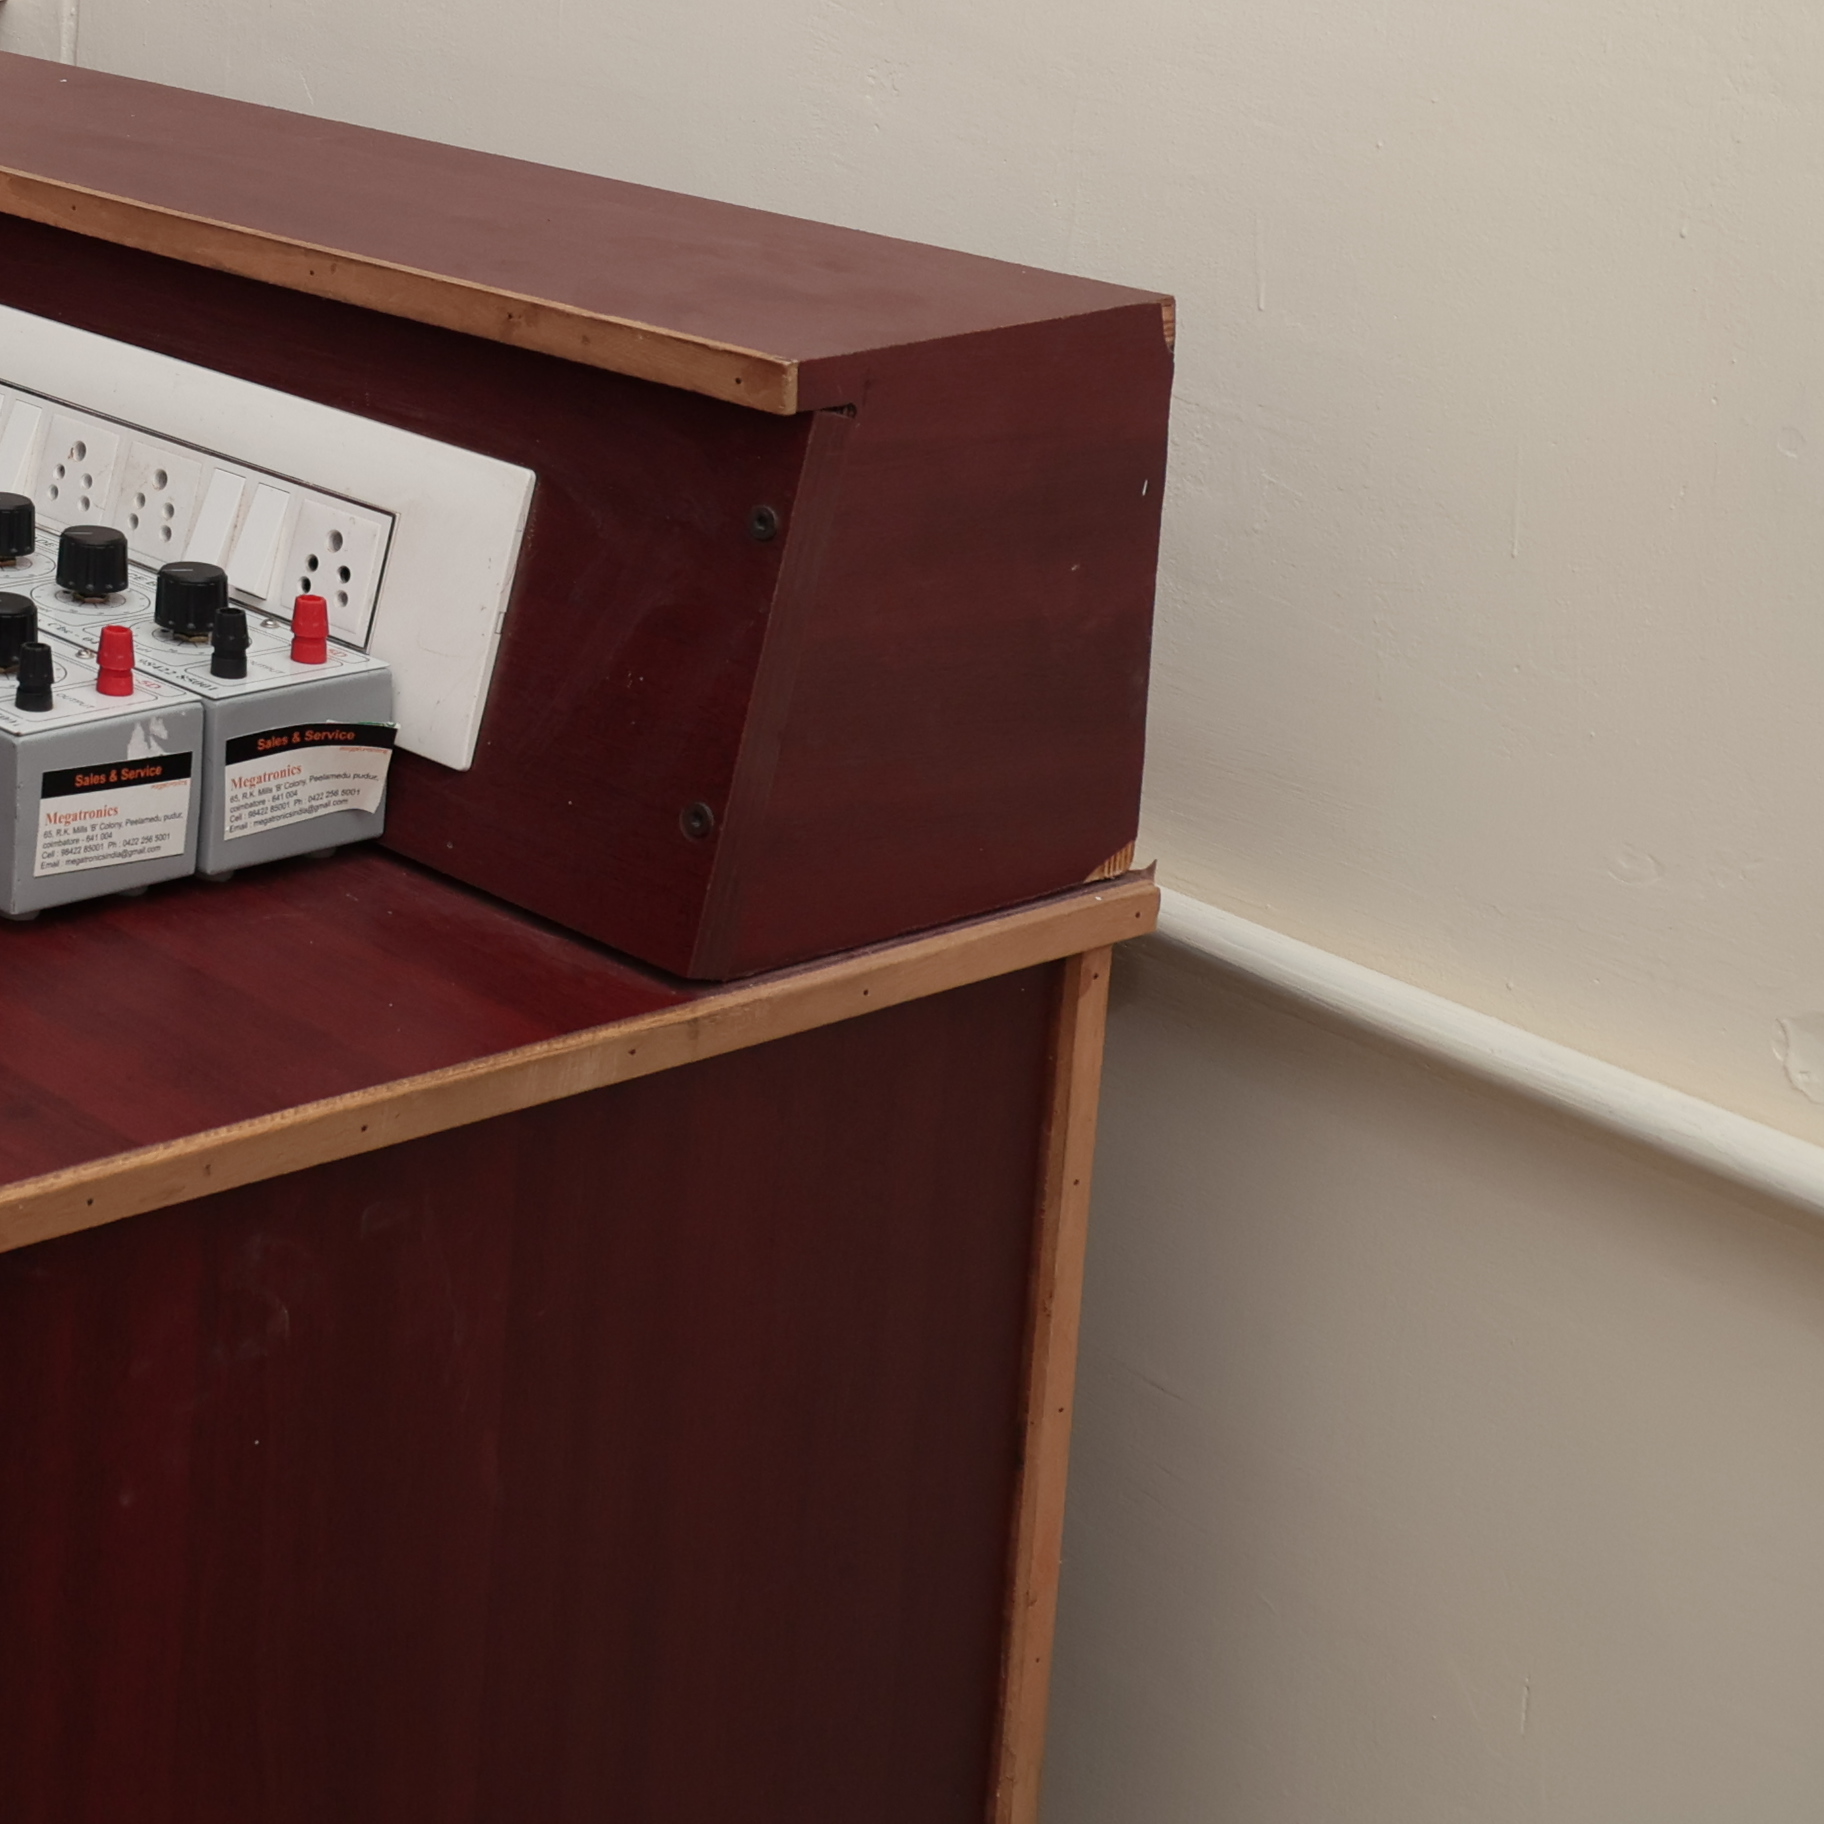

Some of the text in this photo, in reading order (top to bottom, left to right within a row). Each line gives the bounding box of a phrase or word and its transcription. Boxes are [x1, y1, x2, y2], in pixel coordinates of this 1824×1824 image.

[256, 729, 356, 751] Sales & Service
[74, 764, 163, 788] Sales & Service
[230, 763, 303, 791] Megatronics
[257, 787, 273, 797] Mills
[308, 772, 352, 784] Peelamedu
[229, 798, 266, 814] coimbatore
[271, 794, 285, 804] 641
[285, 789, 299, 800] 004
[229, 812, 243, 824] Cell
[247, 807, 269, 819] 98422
[269, 802, 291, 813] 85001
[307, 794, 324, 804] 0422
[324, 791, 339, 800] 256
[340, 788, 361, 797] 5001
[44, 804, 120, 827] Megatronics
[72, 825, 88, 835] Mills
[124, 816, 162, 827] Peelamedu
[229, 823, 249, 833] Email
[253, 798, 349, 827] megatronicsindia@gmail.com
[41, 849, 56, 861] Cell
[60, 846, 82, 857] 98422
[83, 843, 105, 854] 85001
[122, 836, 140, 848] 0422
[140, 835, 154, 845] 256
[154, 832, 171, 843] 5001
[42, 837, 80, 850] coimbatore
[85, 834, 99, 843] 641
[100, 831, 113, 841] 004
[40, 860, 60, 871] Email
[65, 844, 162, 867] megatronicsindia@gmail.com
